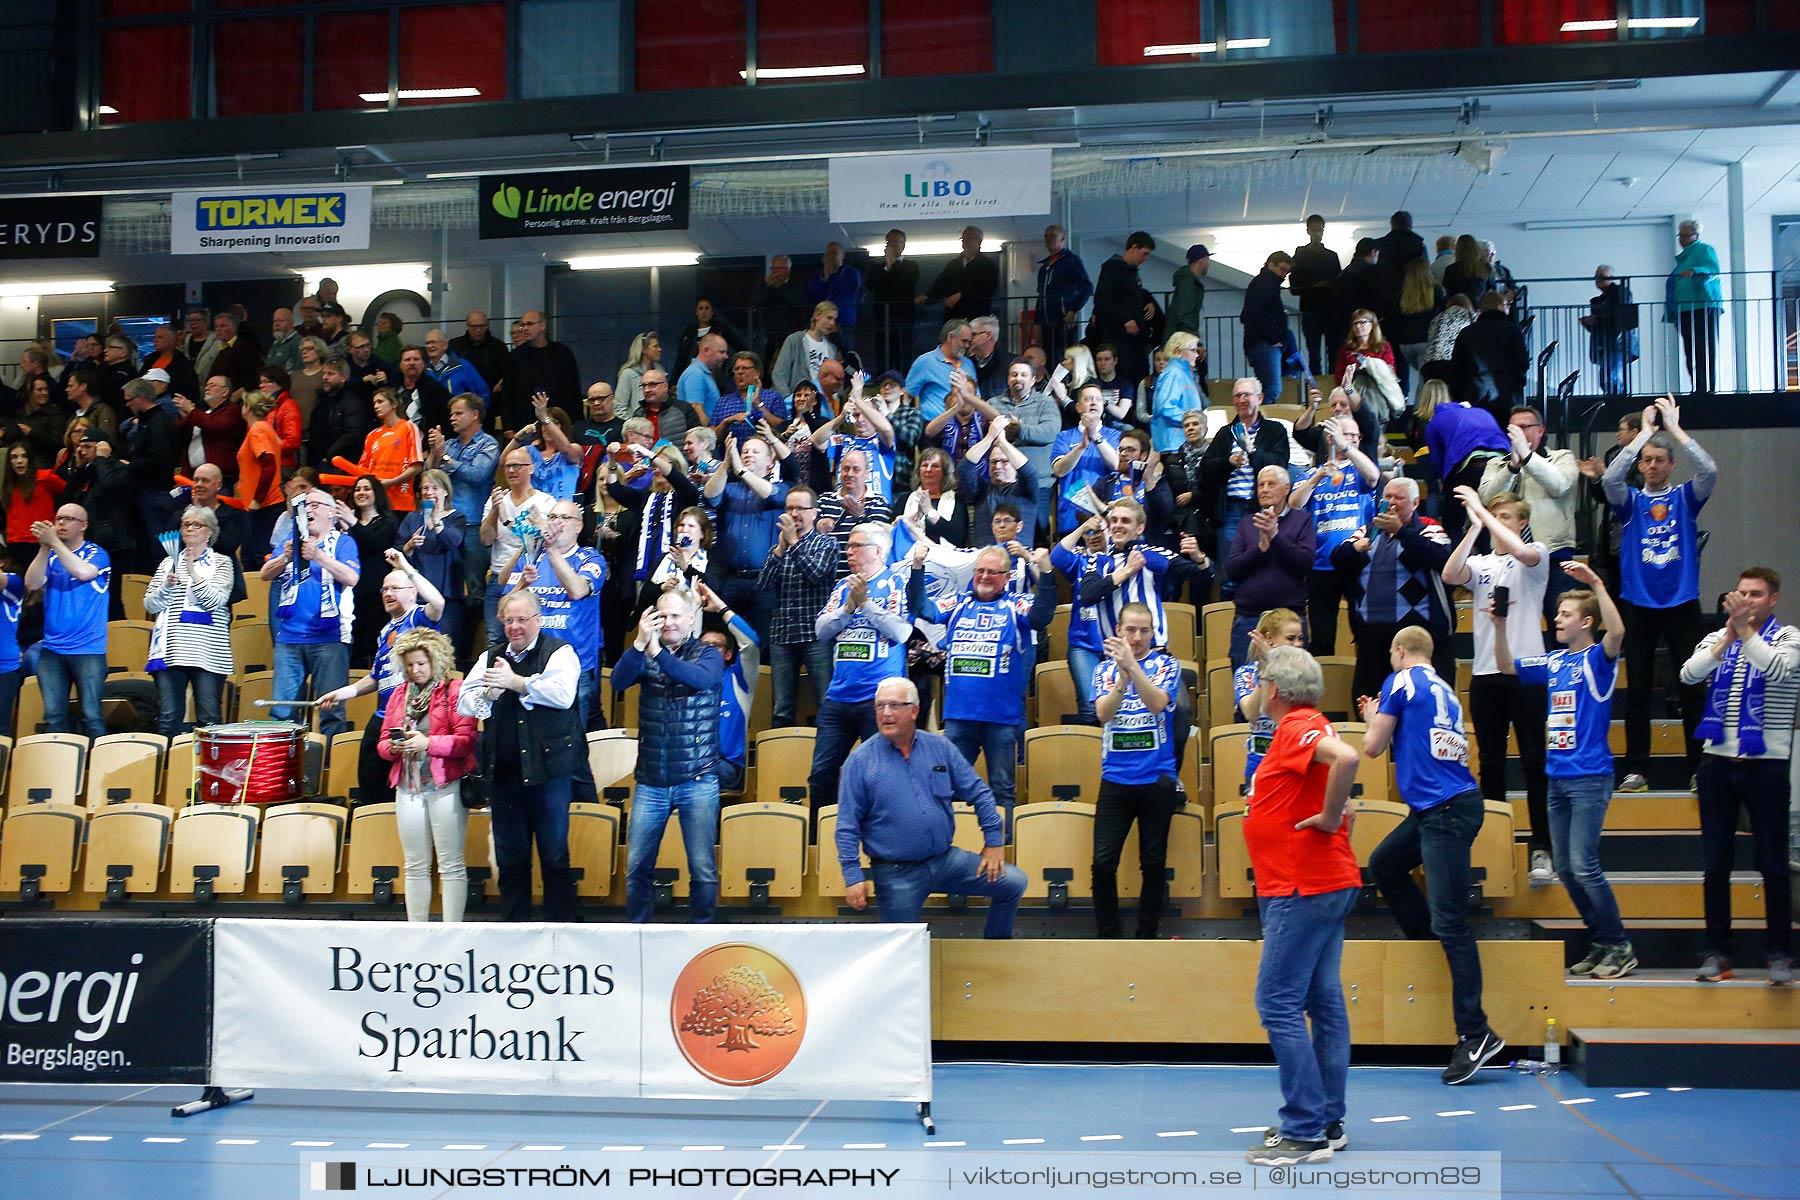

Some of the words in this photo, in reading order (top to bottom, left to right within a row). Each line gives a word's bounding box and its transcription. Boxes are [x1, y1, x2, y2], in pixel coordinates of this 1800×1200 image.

[200, 196, 341, 227] TORMEK
[524, 186, 595, 214] Linde
[598, 181, 677, 213] energi
[524, 218, 561, 229] Personlig
[561, 217, 588, 227] värme.
[590, 216, 609, 226] Kraft
[610, 214, 627, 224] från
[628, 213, 674, 224] Bergslagen.
[200, 235, 271, 249] Sharpening
[275, 233, 341, 246] Innovation
[328, 946, 615, 1010] Bergslagens
[358, 1010, 586, 1072] Sparbank
[7, 1043, 132, 1072] Bergslagen.
